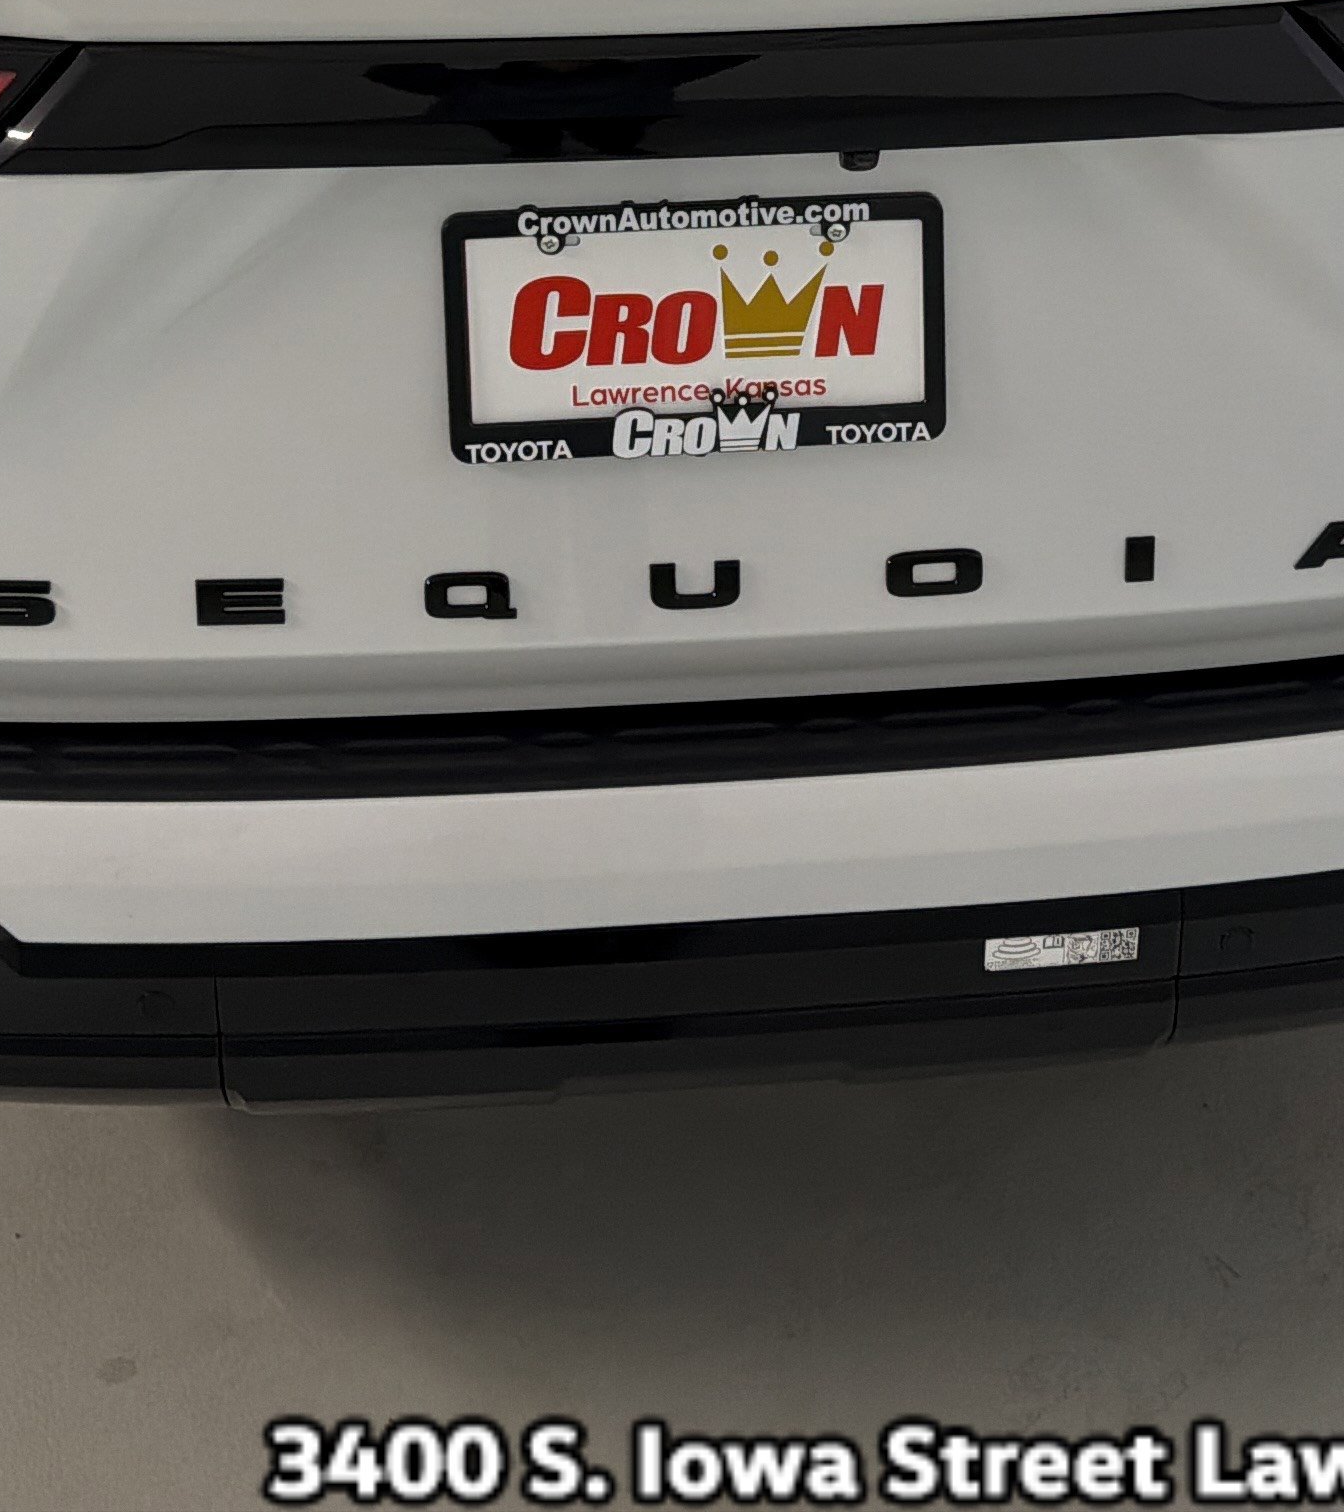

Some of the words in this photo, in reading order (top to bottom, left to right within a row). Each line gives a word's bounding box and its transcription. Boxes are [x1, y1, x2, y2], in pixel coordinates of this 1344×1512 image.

[517, 202, 871, 237] CrownAutomotive.com
[509, 242, 885, 371] CROWN
[726, 377, 827, 399] Kansas
[612, 390, 802, 460] CROWN
[826, 421, 932, 447] TOYOTA
[465, 440, 573, 465] TOYOTA
